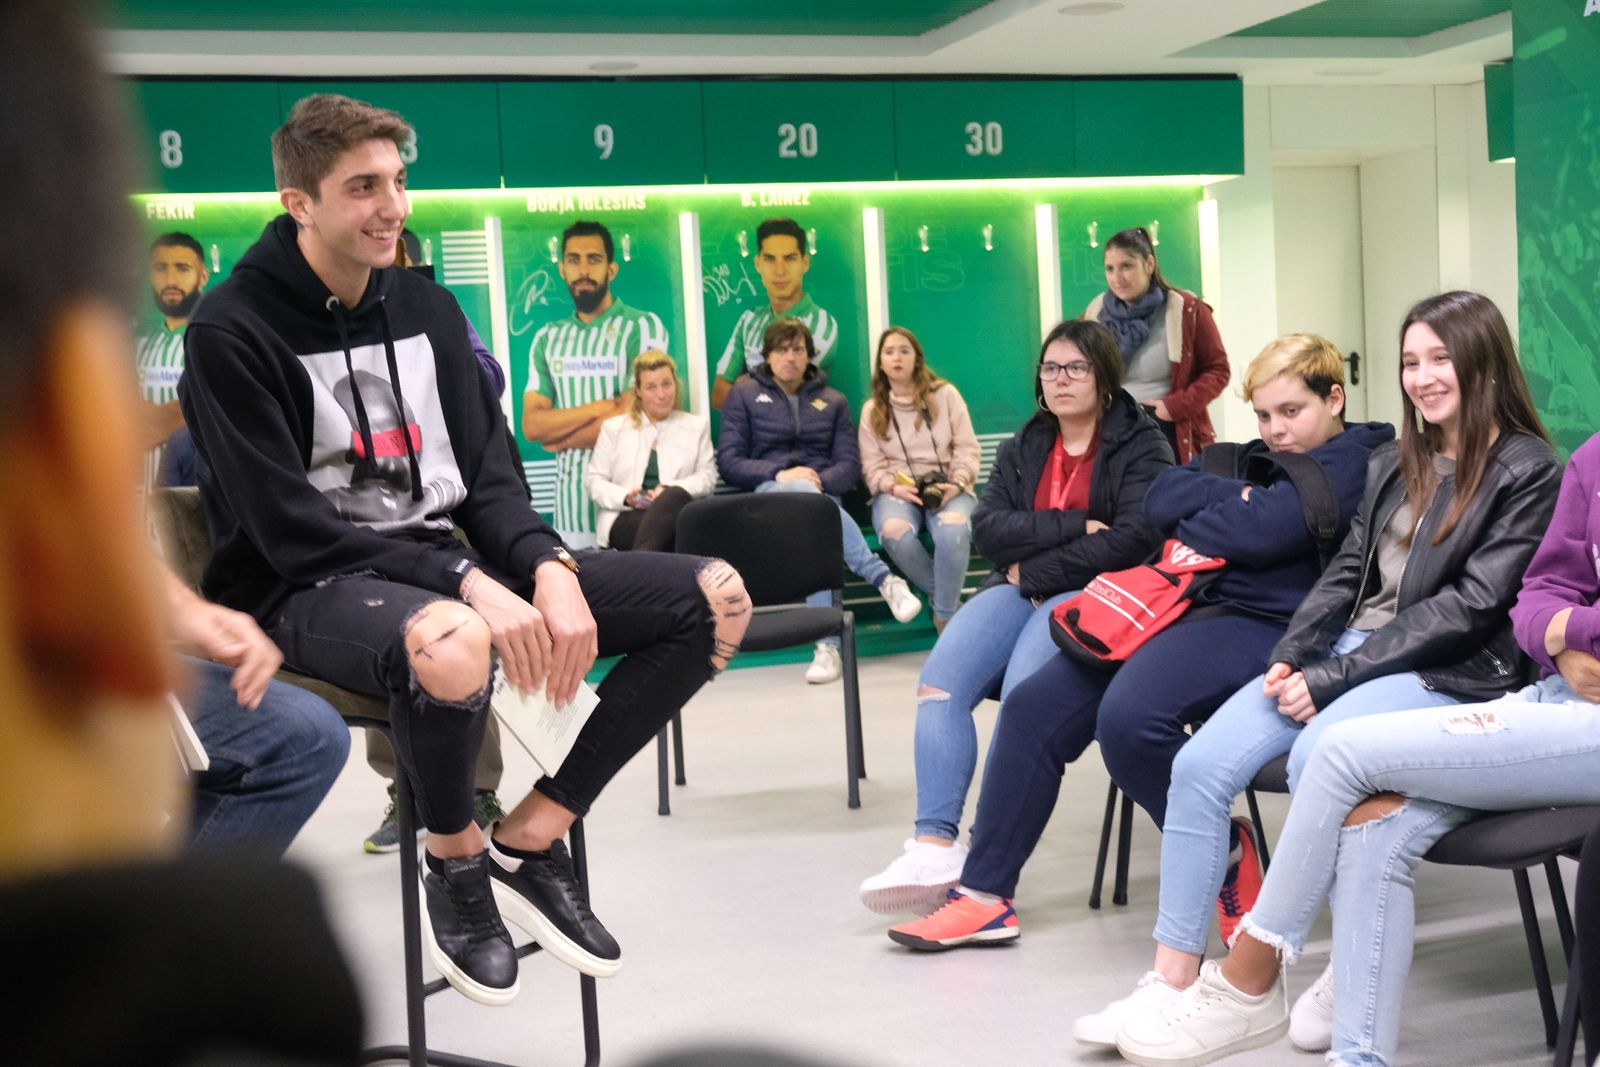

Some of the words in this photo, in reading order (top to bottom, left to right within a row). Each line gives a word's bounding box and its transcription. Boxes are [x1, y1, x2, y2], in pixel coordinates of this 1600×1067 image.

[159, 130, 183, 168] 8
[593, 124, 614, 160] 9
[778, 123, 818, 158] 20
[964, 121, 1003, 156] 30
[145, 201, 195, 220] FEKIR
[527, 192, 575, 214] BORJA
